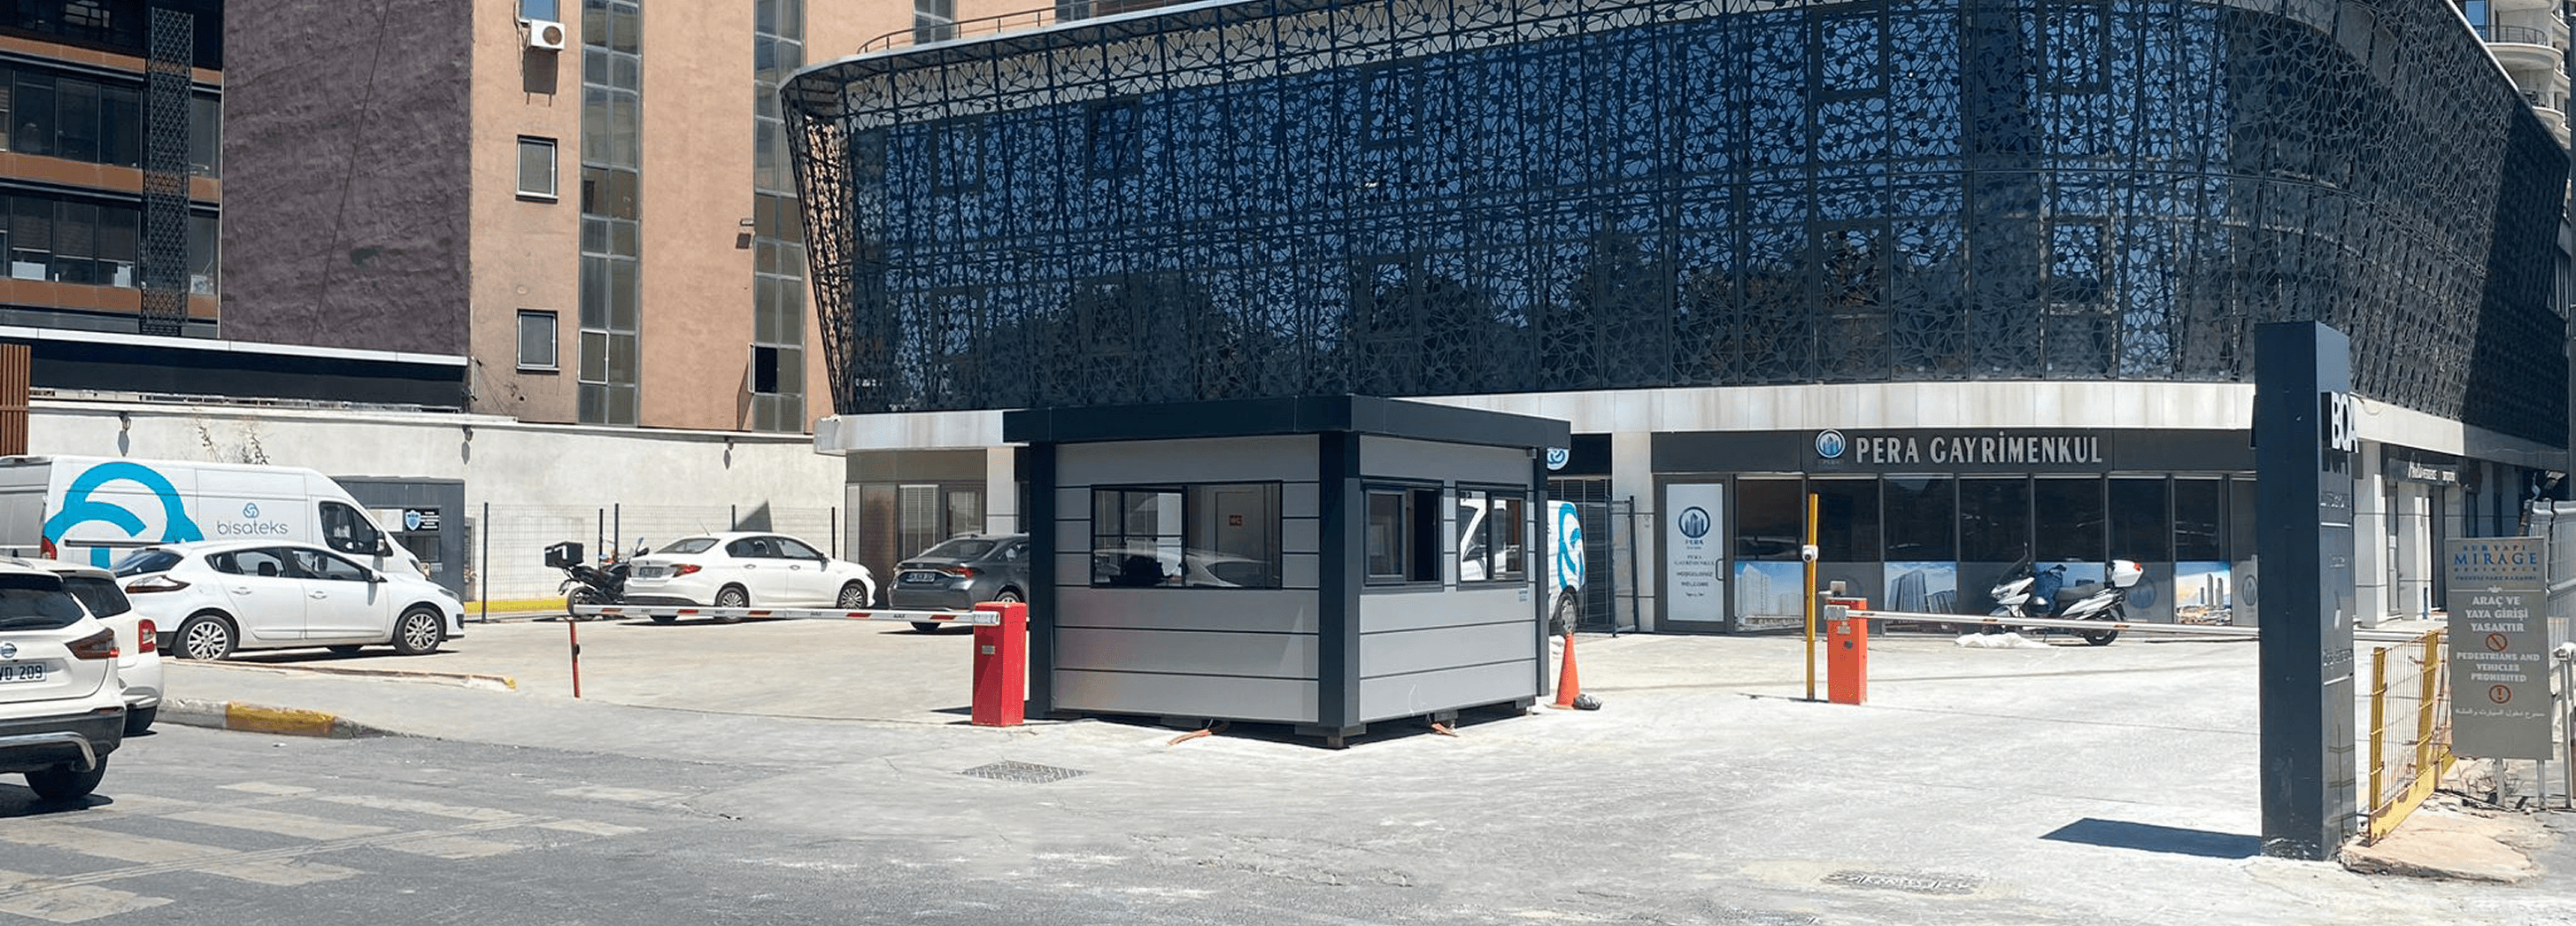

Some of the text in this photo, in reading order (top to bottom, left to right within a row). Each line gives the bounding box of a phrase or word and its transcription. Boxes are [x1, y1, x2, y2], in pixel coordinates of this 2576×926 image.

[1855, 431, 2102, 464] PERA GAYRİMENKUL
[217, 520, 289, 535] bisateks
[2455, 552, 2537, 565] MIRAGE
[2472, 596, 2520, 607] ARAÇ VE
[2465, 607, 2528, 621] YAYA GİRİŞİ
[2470, 623, 2525, 632] YASAKTIR
[2456, 652, 2518, 660] PEDESTRIANS
[19, 665, 42, 680] 209
[2476, 663, 2519, 672] VEHICLES
